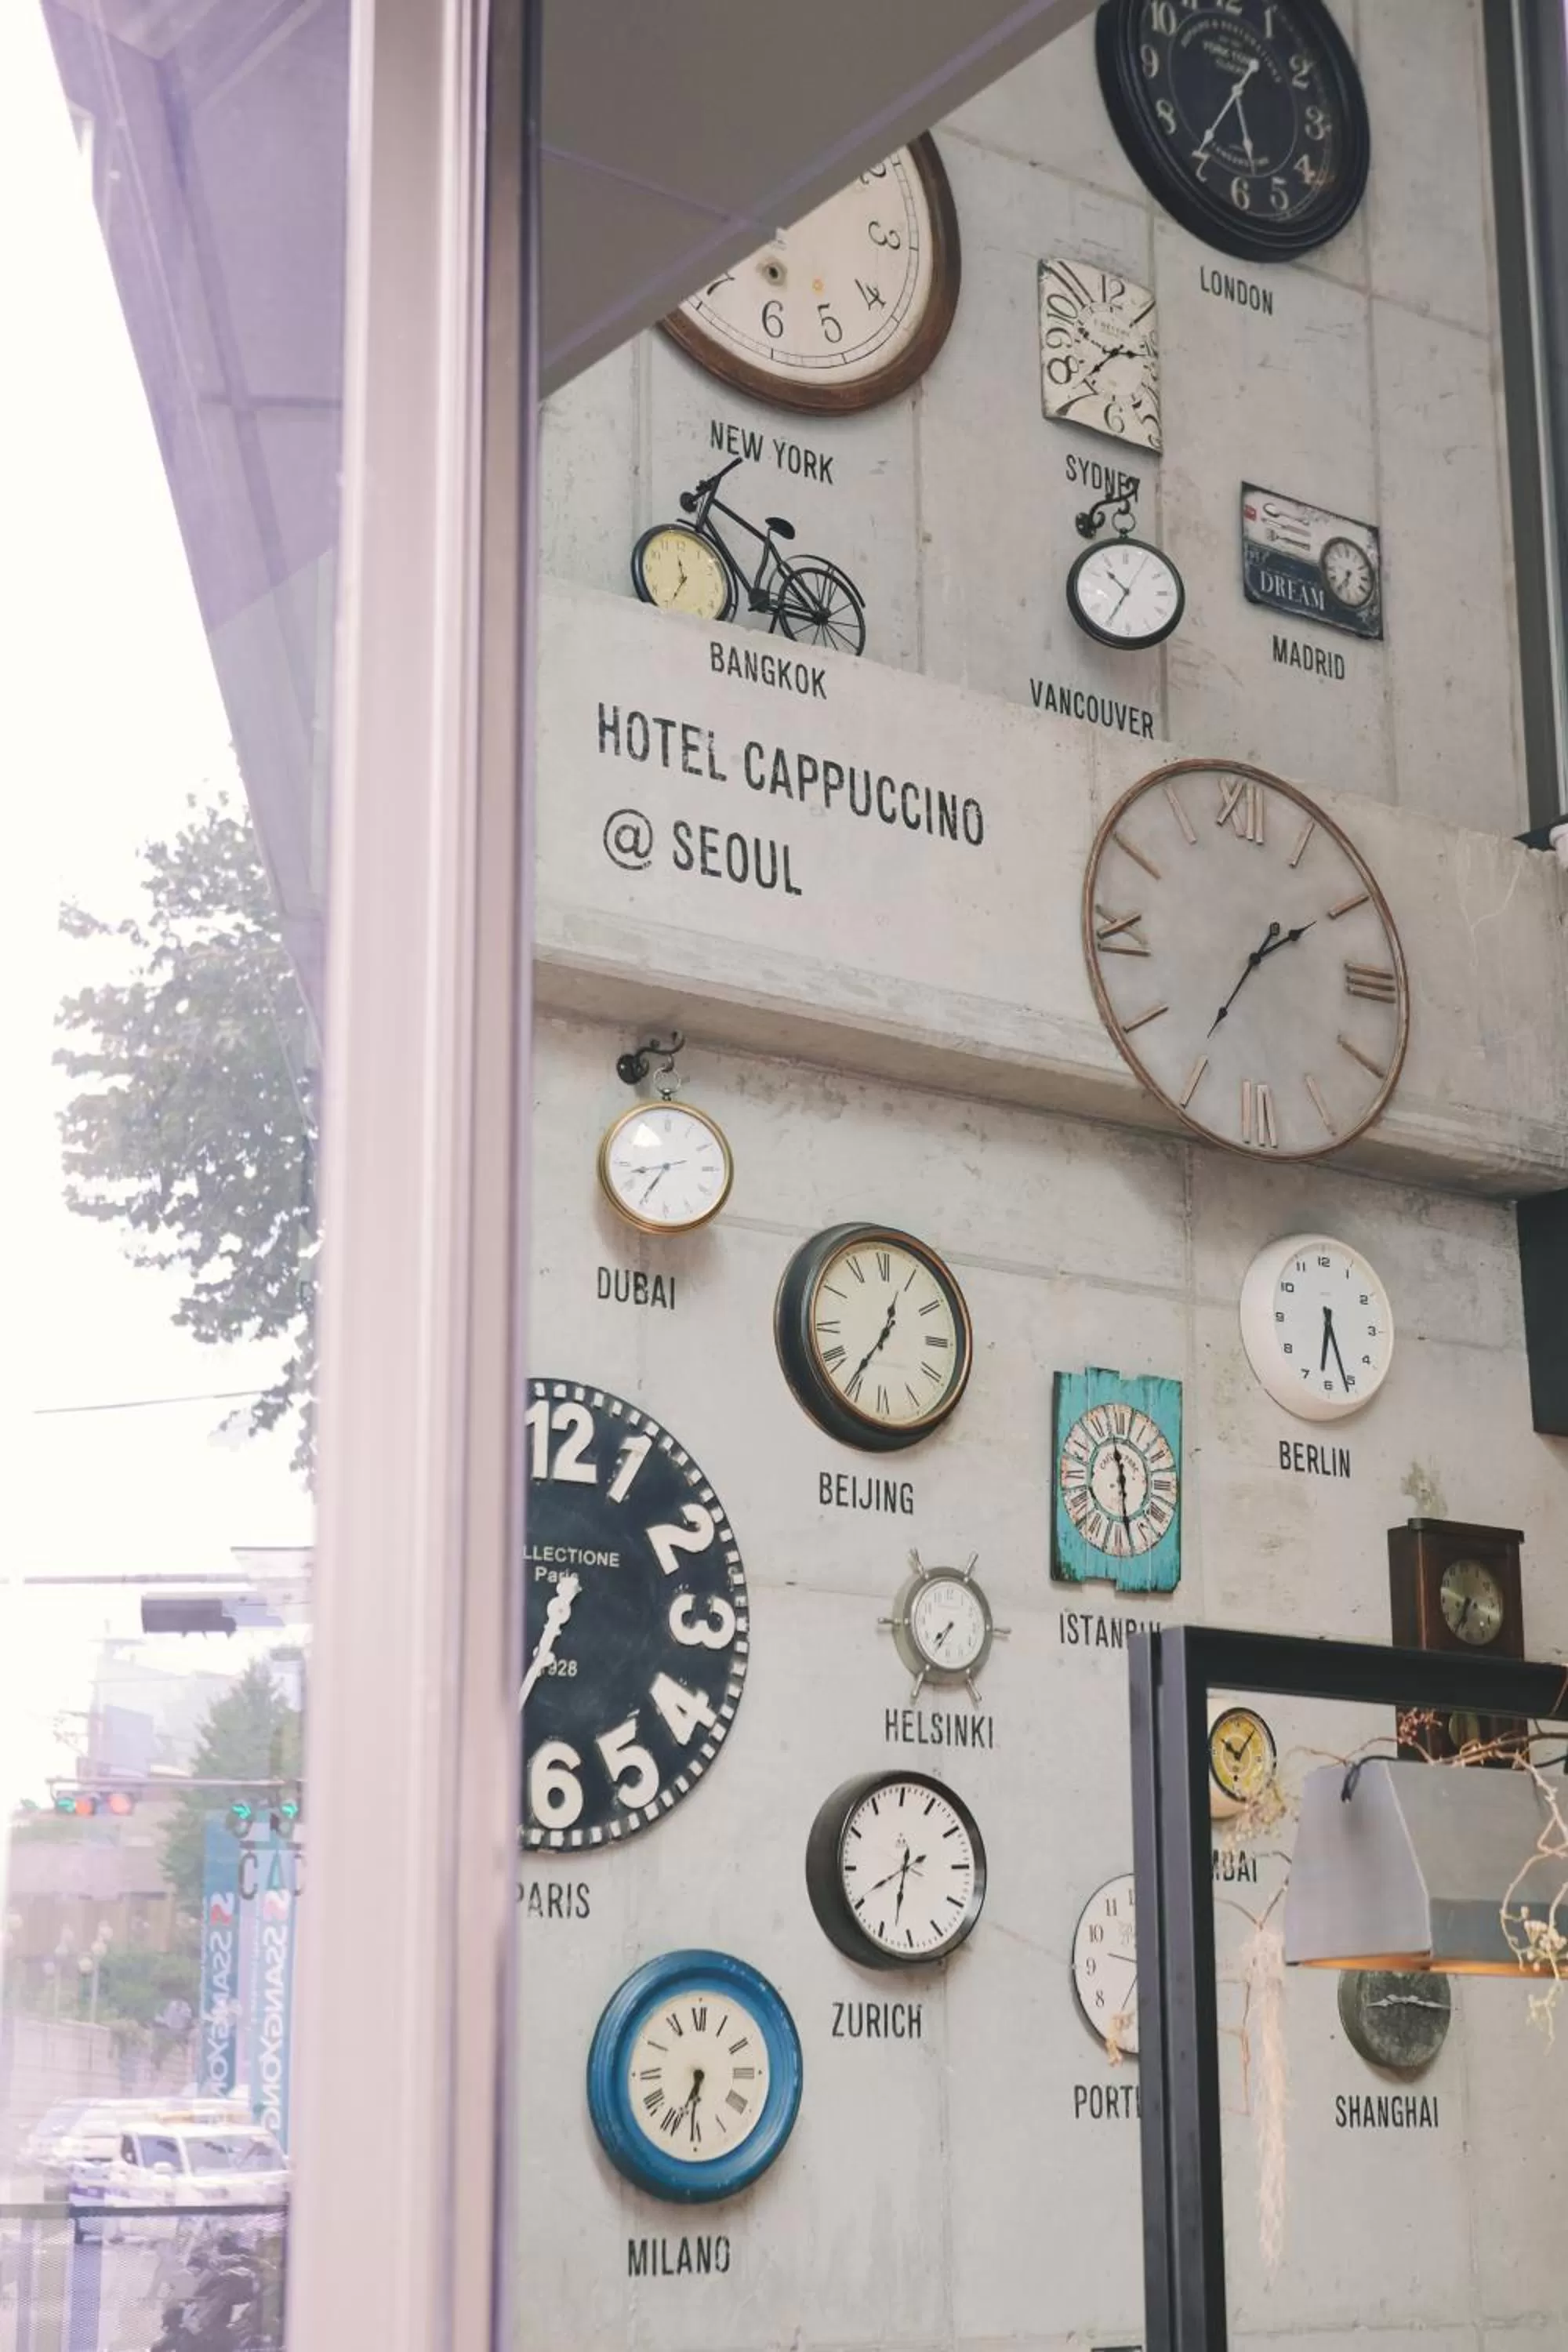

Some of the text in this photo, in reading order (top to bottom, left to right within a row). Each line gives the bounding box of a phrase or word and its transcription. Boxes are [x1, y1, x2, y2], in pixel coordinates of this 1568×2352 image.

[1151, 2, 1177, 35] 10
[1141, 44, 1159, 78] 9
[1231, 177, 1250, 210] 6
[1270, 177, 1289, 210] 5
[868, 220, 900, 251] 3
[855, 278, 886, 310] 4
[1102, 274, 1126, 310] 12
[1200, 266, 1273, 315] LONDON
[762, 300, 783, 339] 6
[817, 303, 844, 343] 5
[1047, 355, 1079, 385] 8
[1103, 402, 1124, 434] 6
[710, 419, 833, 485] NEW YORK
[1261, 570, 1324, 611] DREAM
[710, 641, 827, 699] BANGKOK
[1272, 634, 1345, 680] MADRID
[1029, 678, 1154, 739] VANCOUVER
[598, 702, 984, 846] HOTEL CAPPUCCINO
[603, 808, 802, 896] @ SEOUL
[1318, 1256, 1330, 1268] 12
[597, 1266, 676, 1310] DUBAI
[524, 1401, 598, 1484] 12
[1279, 1440, 1351, 1479] BERLIN
[607, 1432, 652, 1504] 1
[819, 1472, 914, 1515] BEIJING
[645, 1503, 715, 1575] 2
[669, 1593, 736, 1650] 3
[540, 1660, 578, 1677] 928
[651, 1671, 717, 1746] 4
[885, 1708, 993, 1749] HELSINKI
[596, 1710, 659, 1809] 5
[529, 1740, 583, 1830] 6
[1089, 1923, 1105, 1944] 10
[1086, 1957, 1096, 1976] 9
[1095, 1990, 1105, 2008] 8
[832, 2002, 922, 2039] ZURICH
[1073, 2085, 1142, 2120] PORT
[1335, 2095, 1439, 2129] SHANGHAI
[627, 2236, 731, 2278] MILANO
